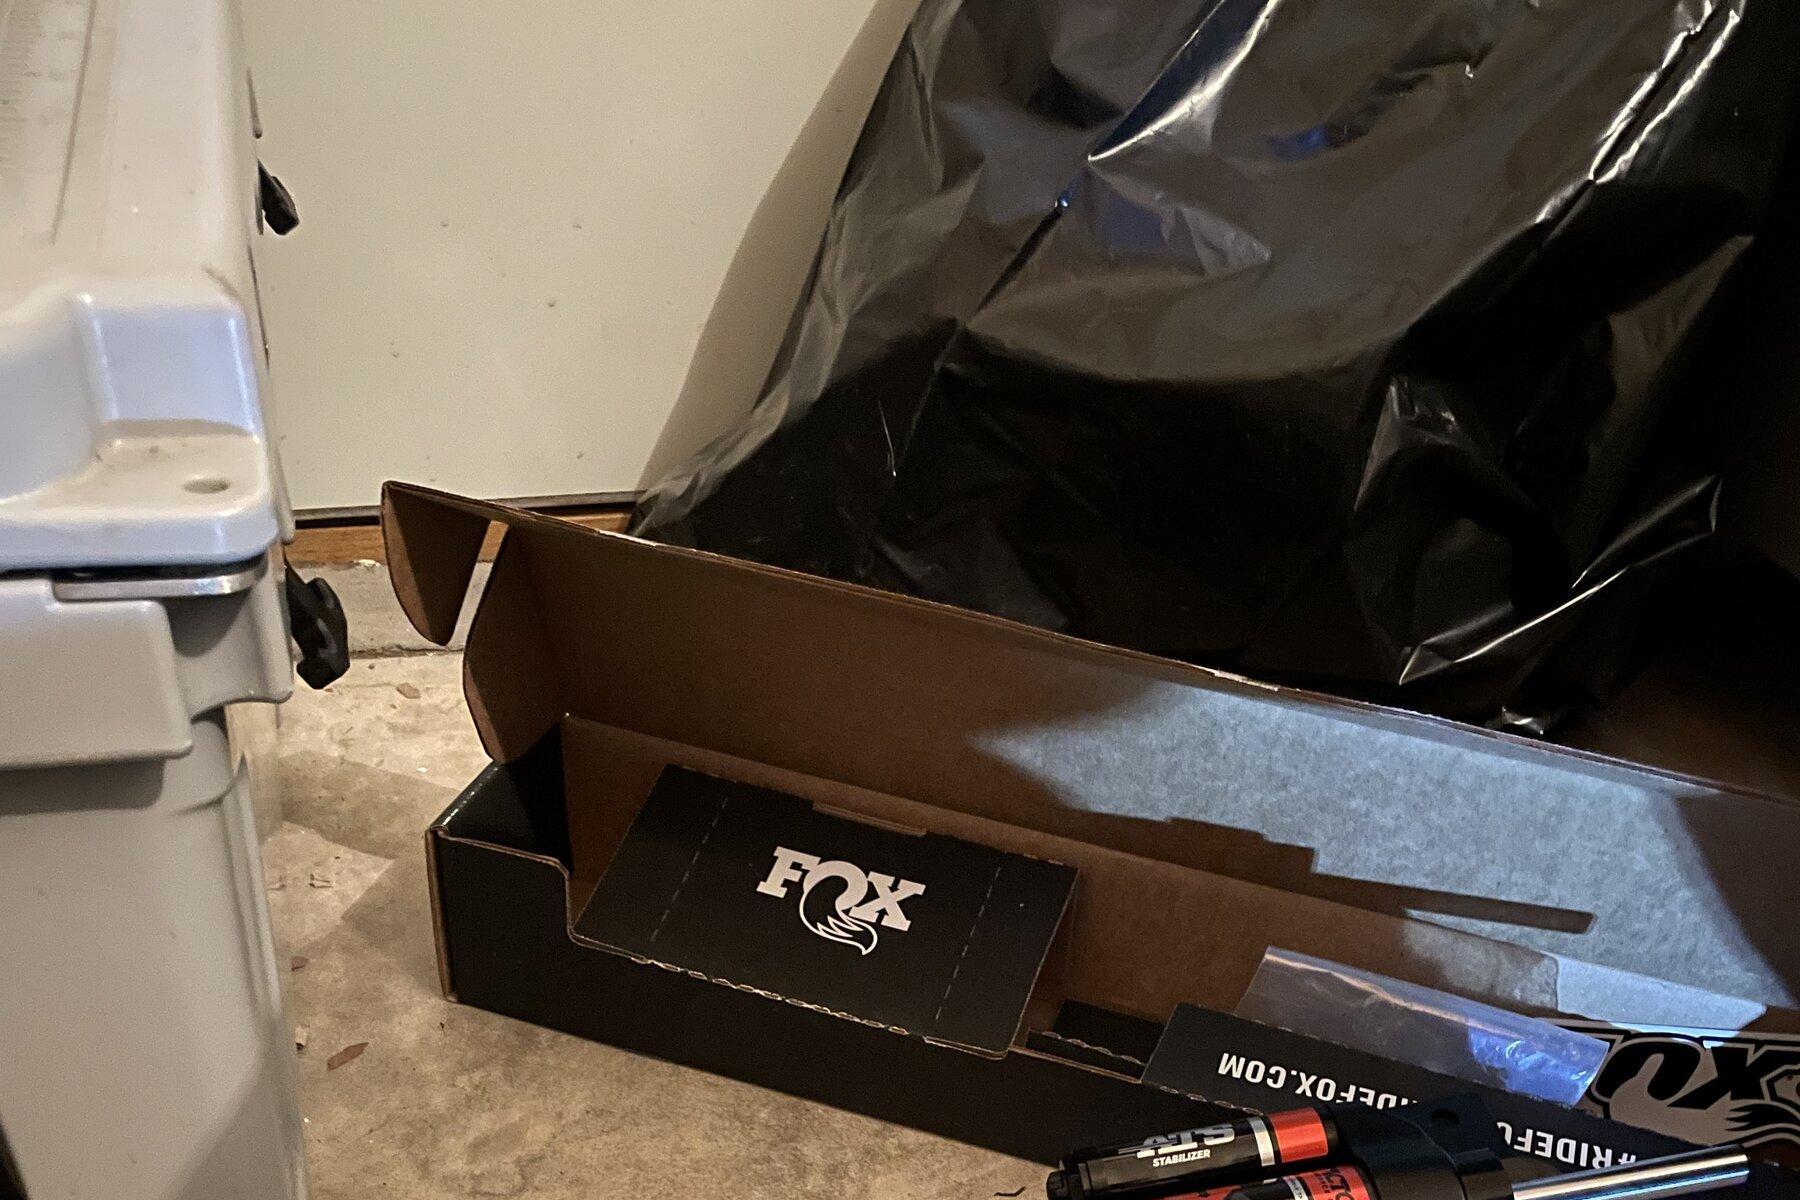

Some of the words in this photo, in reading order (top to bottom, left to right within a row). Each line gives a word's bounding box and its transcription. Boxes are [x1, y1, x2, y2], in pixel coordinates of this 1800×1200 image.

[756, 846, 927, 956] FOX
[1133, 1123, 1236, 1159] ATS
[1152, 1149, 1211, 1168] STABILIZER
